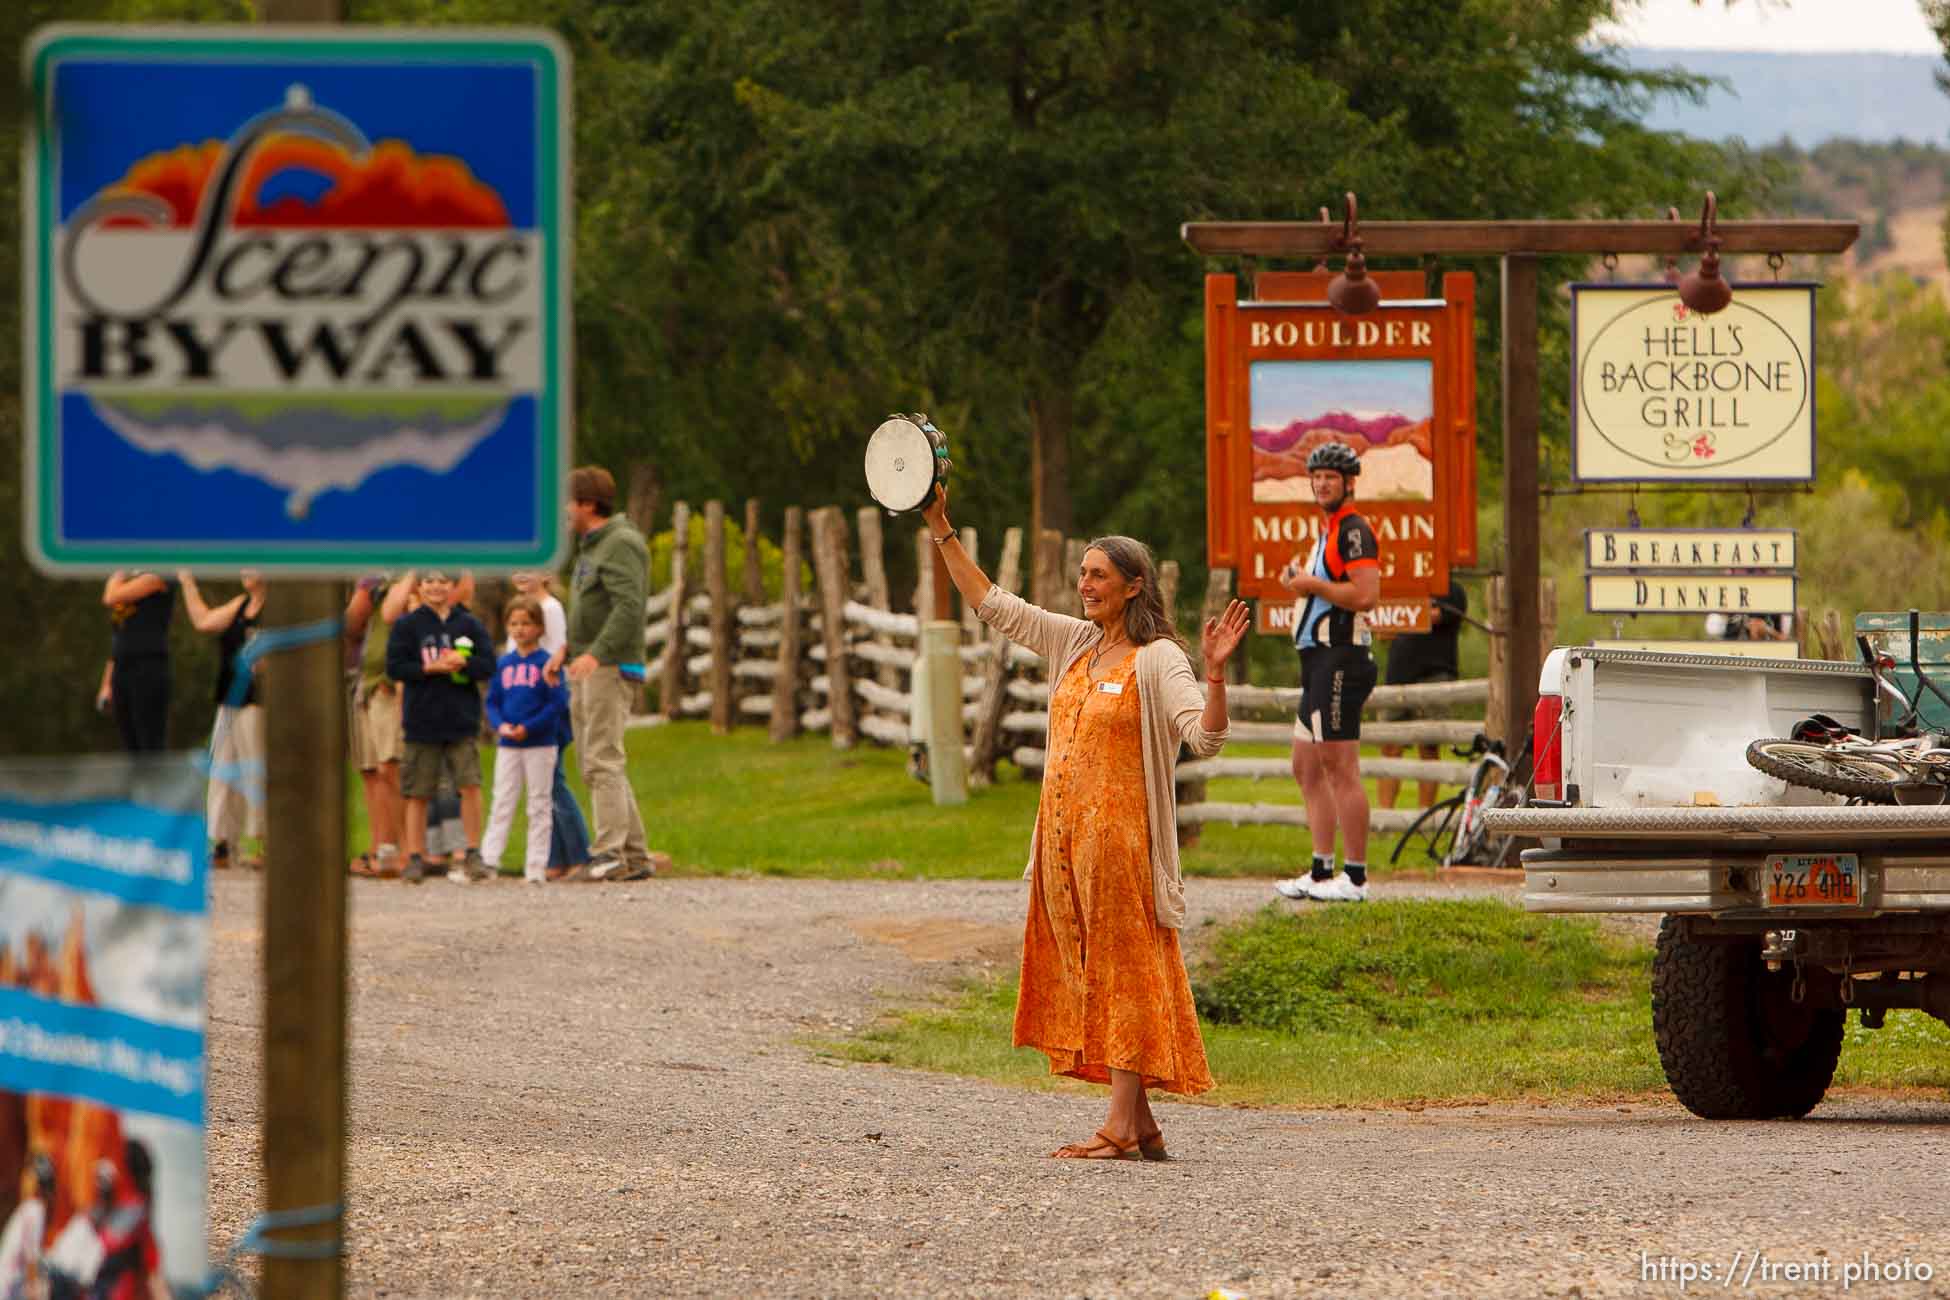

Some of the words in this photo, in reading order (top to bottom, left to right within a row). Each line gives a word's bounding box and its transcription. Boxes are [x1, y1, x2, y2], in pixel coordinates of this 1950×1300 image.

[62, 104, 530, 324] Scenic
[1250, 320, 1432, 347] BOULDER
[1644, 324, 1744, 357] HELL'S
[74, 317, 526, 384] BYWAY
[1600, 361, 1792, 393] BACKBONE
[1641, 396, 1749, 427] GRILL
[1252, 515, 1435, 542] MOUAIN
[1604, 534, 1782, 564] BREAKFAST
[1253, 552, 1435, 579] LGE
[1635, 579, 1750, 608] DINNER
[501, 664, 540, 689] GAP
[1773, 872, 1807, 899] Y26
